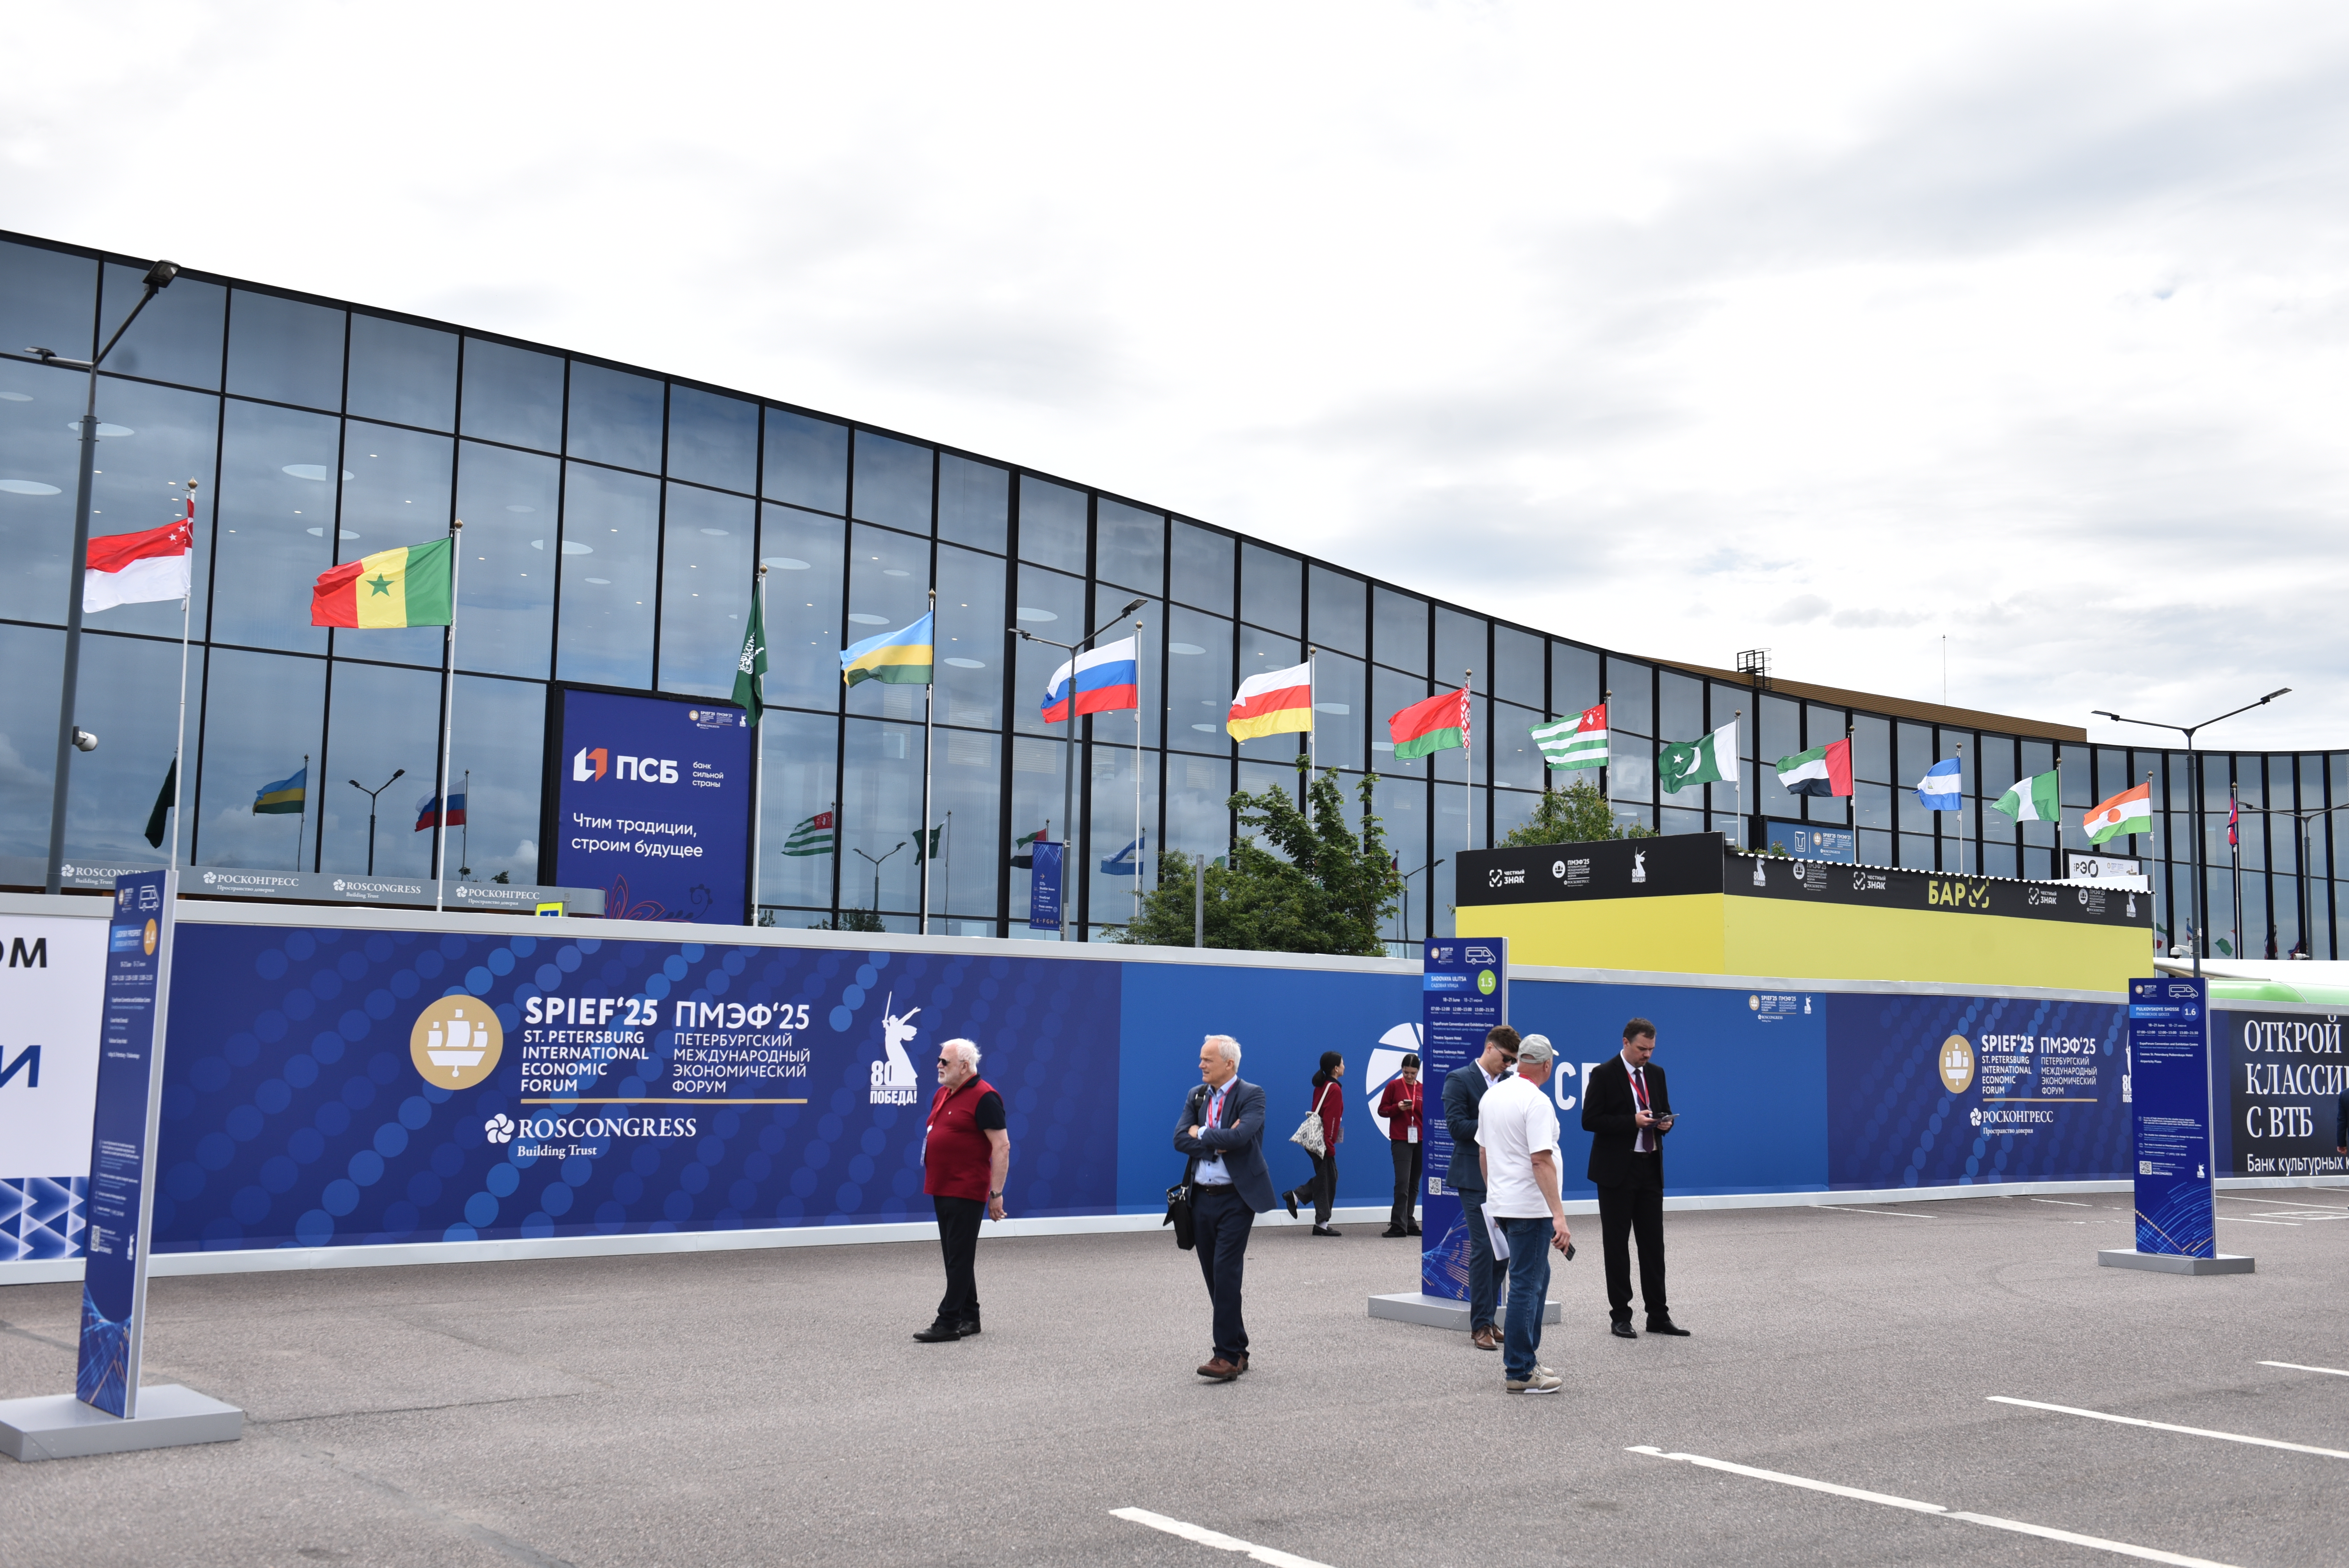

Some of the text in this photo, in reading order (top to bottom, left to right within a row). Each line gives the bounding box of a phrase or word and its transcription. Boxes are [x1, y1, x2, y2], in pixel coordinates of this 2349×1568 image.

[617, 755, 679, 783] ПСБ
[693, 770, 724, 779] сильной
[573, 813, 697, 837] Чтим традиции,
[571, 837, 703, 858] строим будущее
[217, 874, 299, 886] РОСКОНГРЕСС
[1504, 876, 1524, 884] ЗНАК
[1867, 880, 1886, 890] ЗНАК
[346, 882, 421, 894] ROSCONGRESS
[469, 889, 540, 900] РОСКОНГРЕСС
[1928, 880, 1966, 906] БАР
[146, 930, 155, 944] 1.4
[0, 937, 47, 968] М
[1481, 977, 1493, 987] 1.5
[525, 996, 658, 1026] SPIEF'25
[676, 1001, 809, 1029] ПМЭФ'25
[524, 1030, 644, 1044] ST. PETERSBURG
[675, 1032, 792, 1046] ПЕТЕРБУРГСКИЙ
[2244, 1015, 2341, 1053] ОТКРОЙ
[1982, 1034, 2034, 1053] SPIEF'25
[2041, 1037, 2096, 1054] ПМЭФ'25
[523, 1046, 649, 1060] INTERNATIONAL
[674, 1048, 810, 1063] МЕЖДУНАРОДНЫЙ
[1991, 1056, 2029, 1064] PETERSBURG
[2041, 1056, 2089, 1065] ПЕТЕРБУРГСКИЙ
[522, 1063, 608, 1075] ECONOMIC
[673, 1063, 806, 1077] ЭКОНОМИЧЕСКИЙ
[871, 1060, 893, 1086] 80
[2041, 1067, 2097, 1076] МЕЖДУНАРОДНЫЙ
[521, 1079, 577, 1092] FORUM
[672, 1080, 726, 1092] ФОРУМ
[2041, 1076, 2096, 1085] ЭКОНОМИЧЕСКИЙ
[870, 1090, 917, 1106] ПОБЕДА!
[1983, 1111, 2053, 1123] РОСКОНГРЕСС
[2247, 1106, 2313, 1138] С ВТБ
[518, 1118, 696, 1139] ROSCONGRESS
[1983, 1128, 2015, 1136] Пространство
[517, 1144, 597, 1160] Building Trust
[2247, 1154, 2276, 1172] Банк
[2278, 1156, 2343, 1176] культурных
